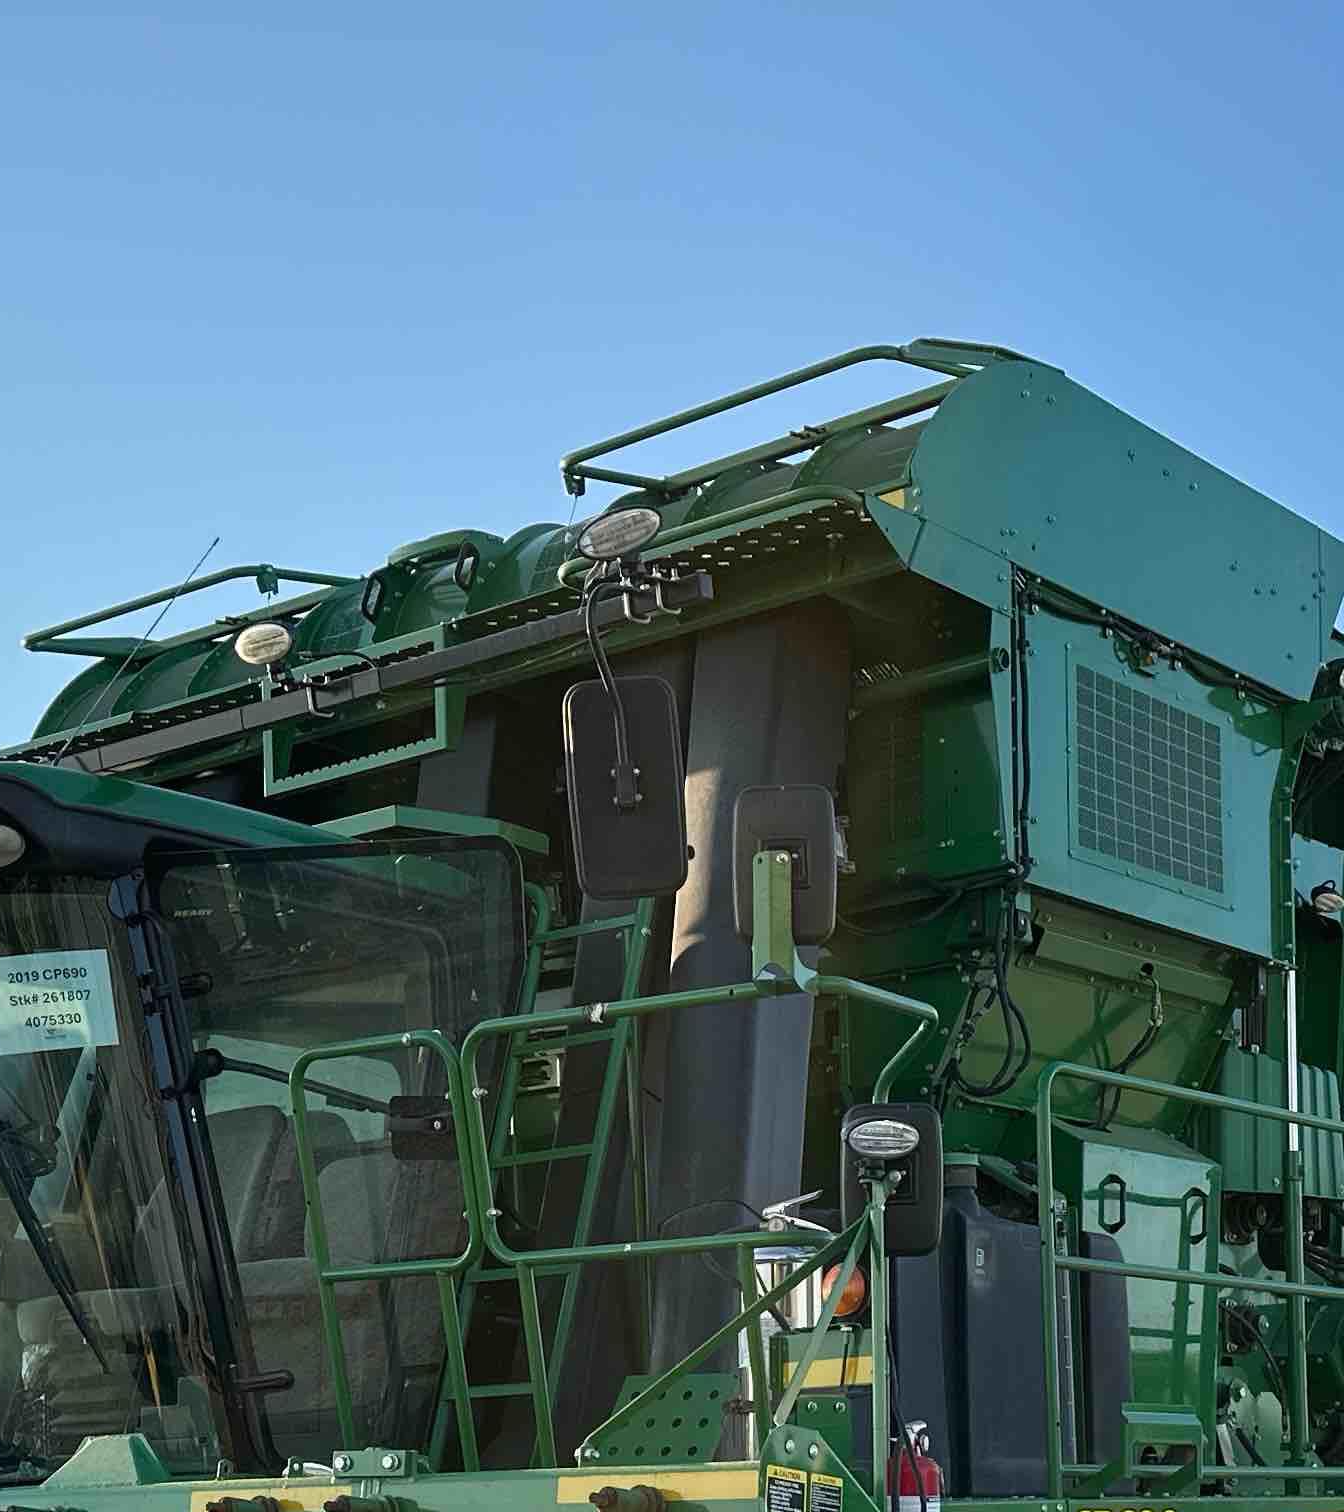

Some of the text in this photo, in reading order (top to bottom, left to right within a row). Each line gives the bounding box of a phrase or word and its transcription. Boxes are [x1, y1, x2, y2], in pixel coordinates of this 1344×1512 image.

[7, 967, 87, 984] 2019 CP690
[9, 989, 91, 1007] Stk# 261807
[24, 1012, 82, 1028] 4075330
